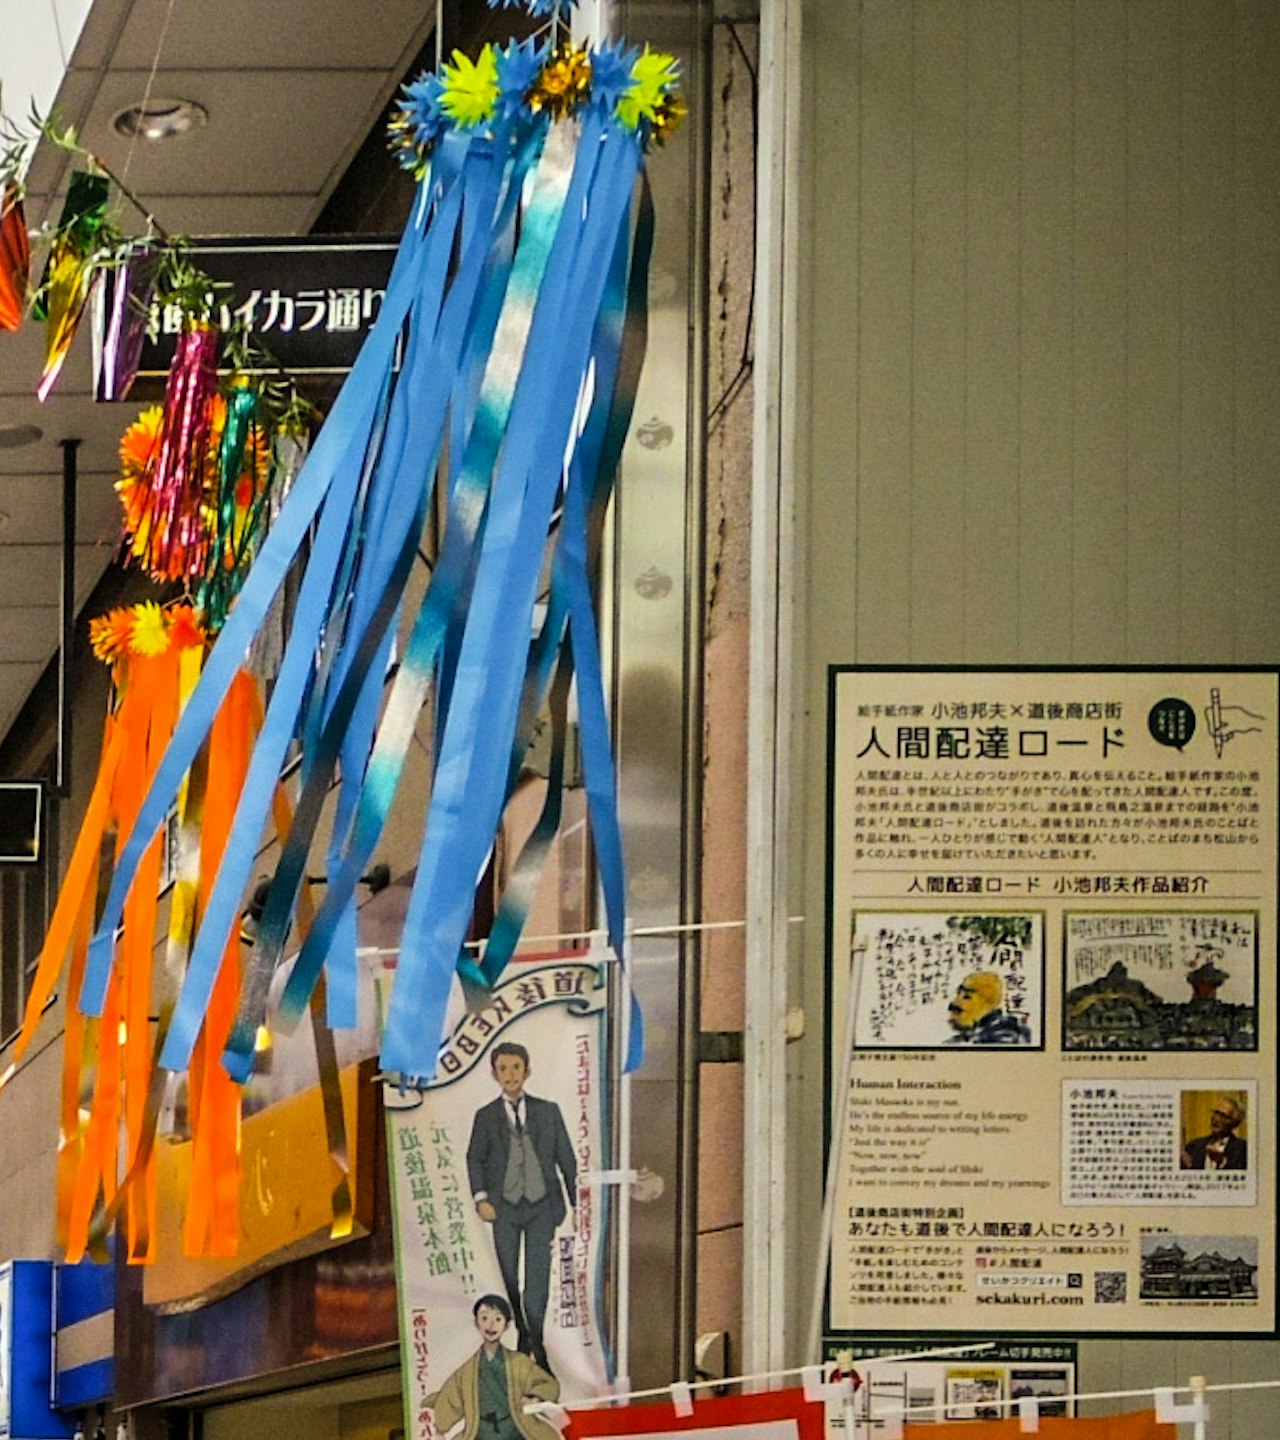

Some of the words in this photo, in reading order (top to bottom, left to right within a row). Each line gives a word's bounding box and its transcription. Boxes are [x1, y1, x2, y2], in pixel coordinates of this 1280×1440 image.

[147, 287, 387, 334] ハイカラ通り
[857, 704, 925, 718] 絵手紙作家
[930, 701, 1123, 720] 小池邦夫×道後商店街
[855, 725, 1125, 761] 人間配達ロード
[906, 876, 1041, 893] 人間配達ロード
[1053, 875, 1210, 893] 小池邦夫作品紹介
[850, 1078, 895, 1089] Human
[897, 1078, 962, 1089] Interaction
[1070, 1088, 1118, 1100] 小池邦夫
[976, 1292, 1084, 1305] sekakuri.com
